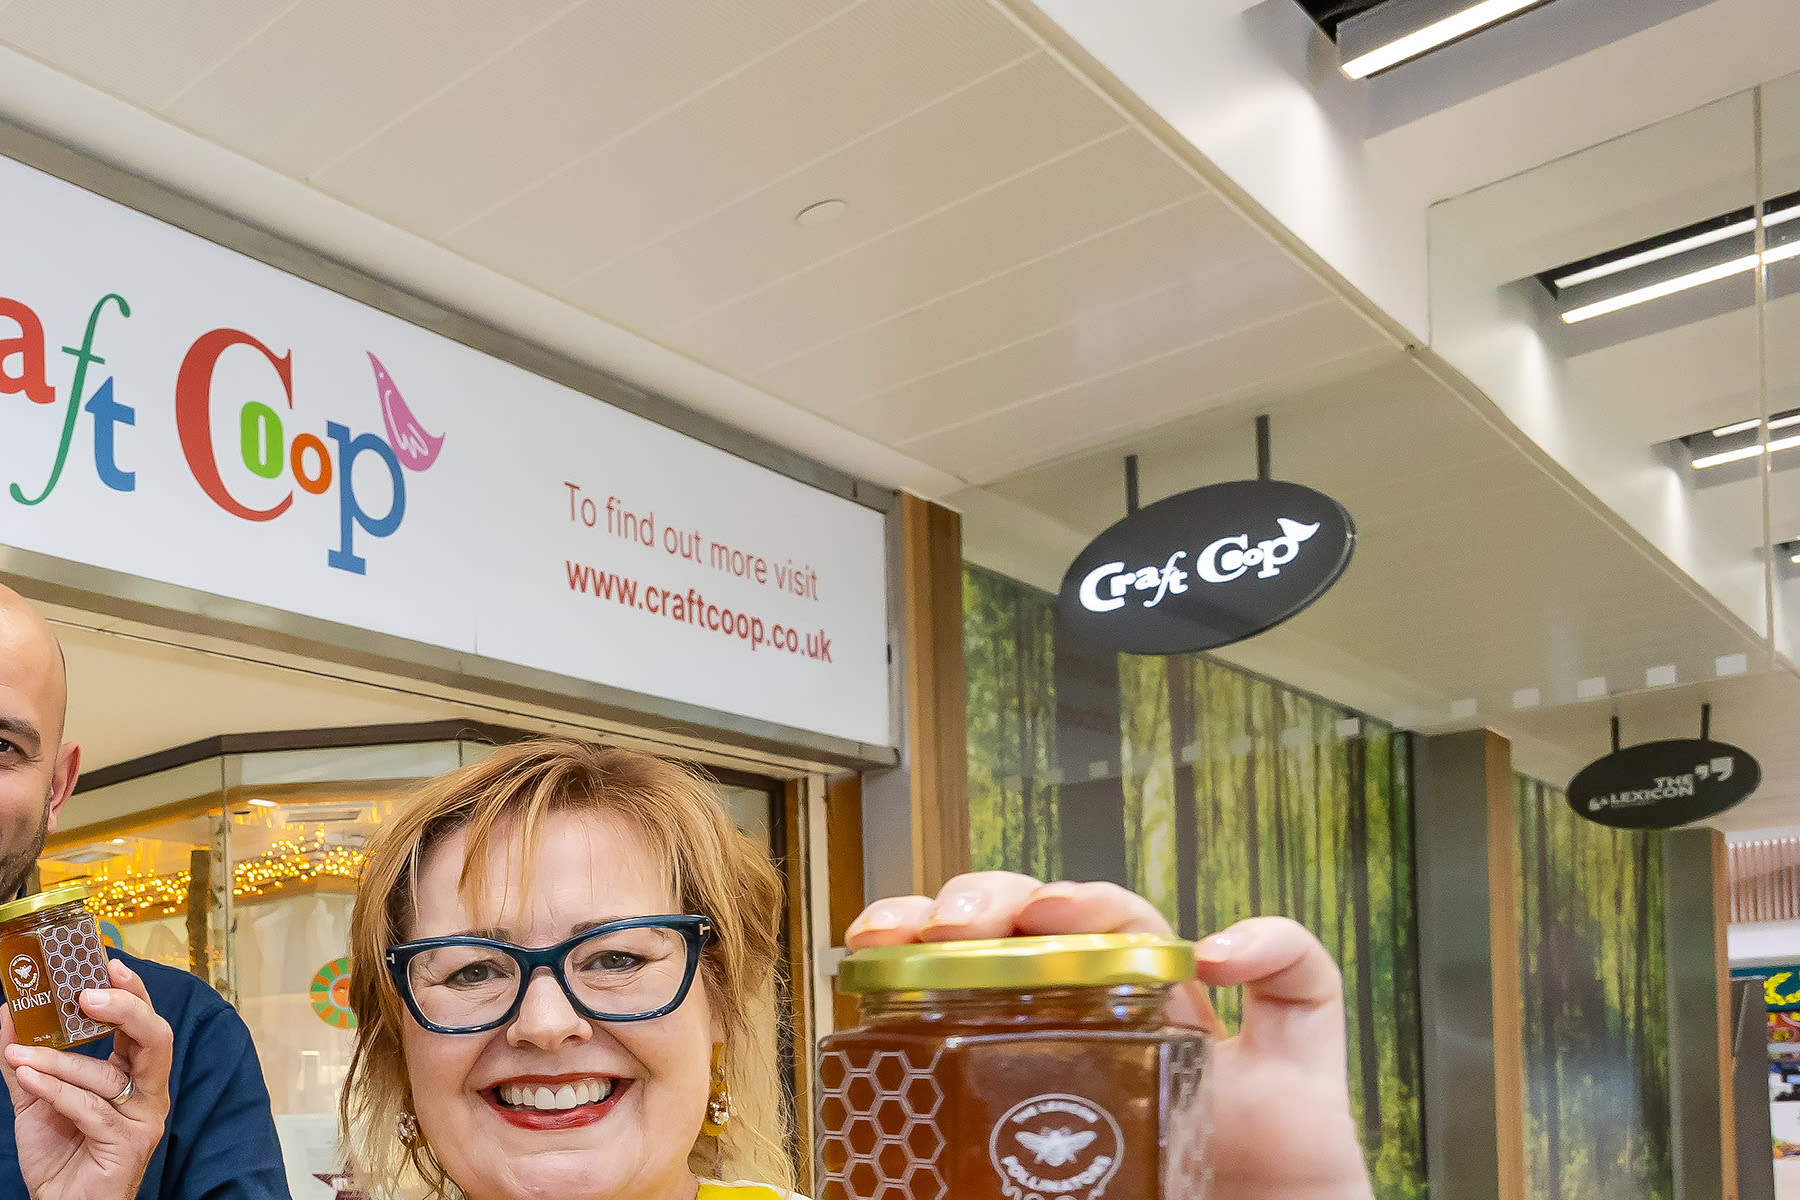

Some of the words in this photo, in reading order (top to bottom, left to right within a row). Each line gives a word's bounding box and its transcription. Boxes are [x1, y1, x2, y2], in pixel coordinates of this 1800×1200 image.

[175, 327, 407, 576] Coop
[564, 481, 597, 528] To
[605, 496, 655, 548] find
[663, 526, 702, 565] out
[710, 541, 768, 585] more
[774, 558, 819, 601] visit
[1079, 550, 1189, 612] Craft
[1196, 534, 1300, 583] Coop
[565, 560, 833, 664] www.craftcoop.co.uk
[1610, 786, 1696, 806] LEXICON
[1653, 773, 1695, 788] THE
[11, 990, 52, 1012] HONEY
